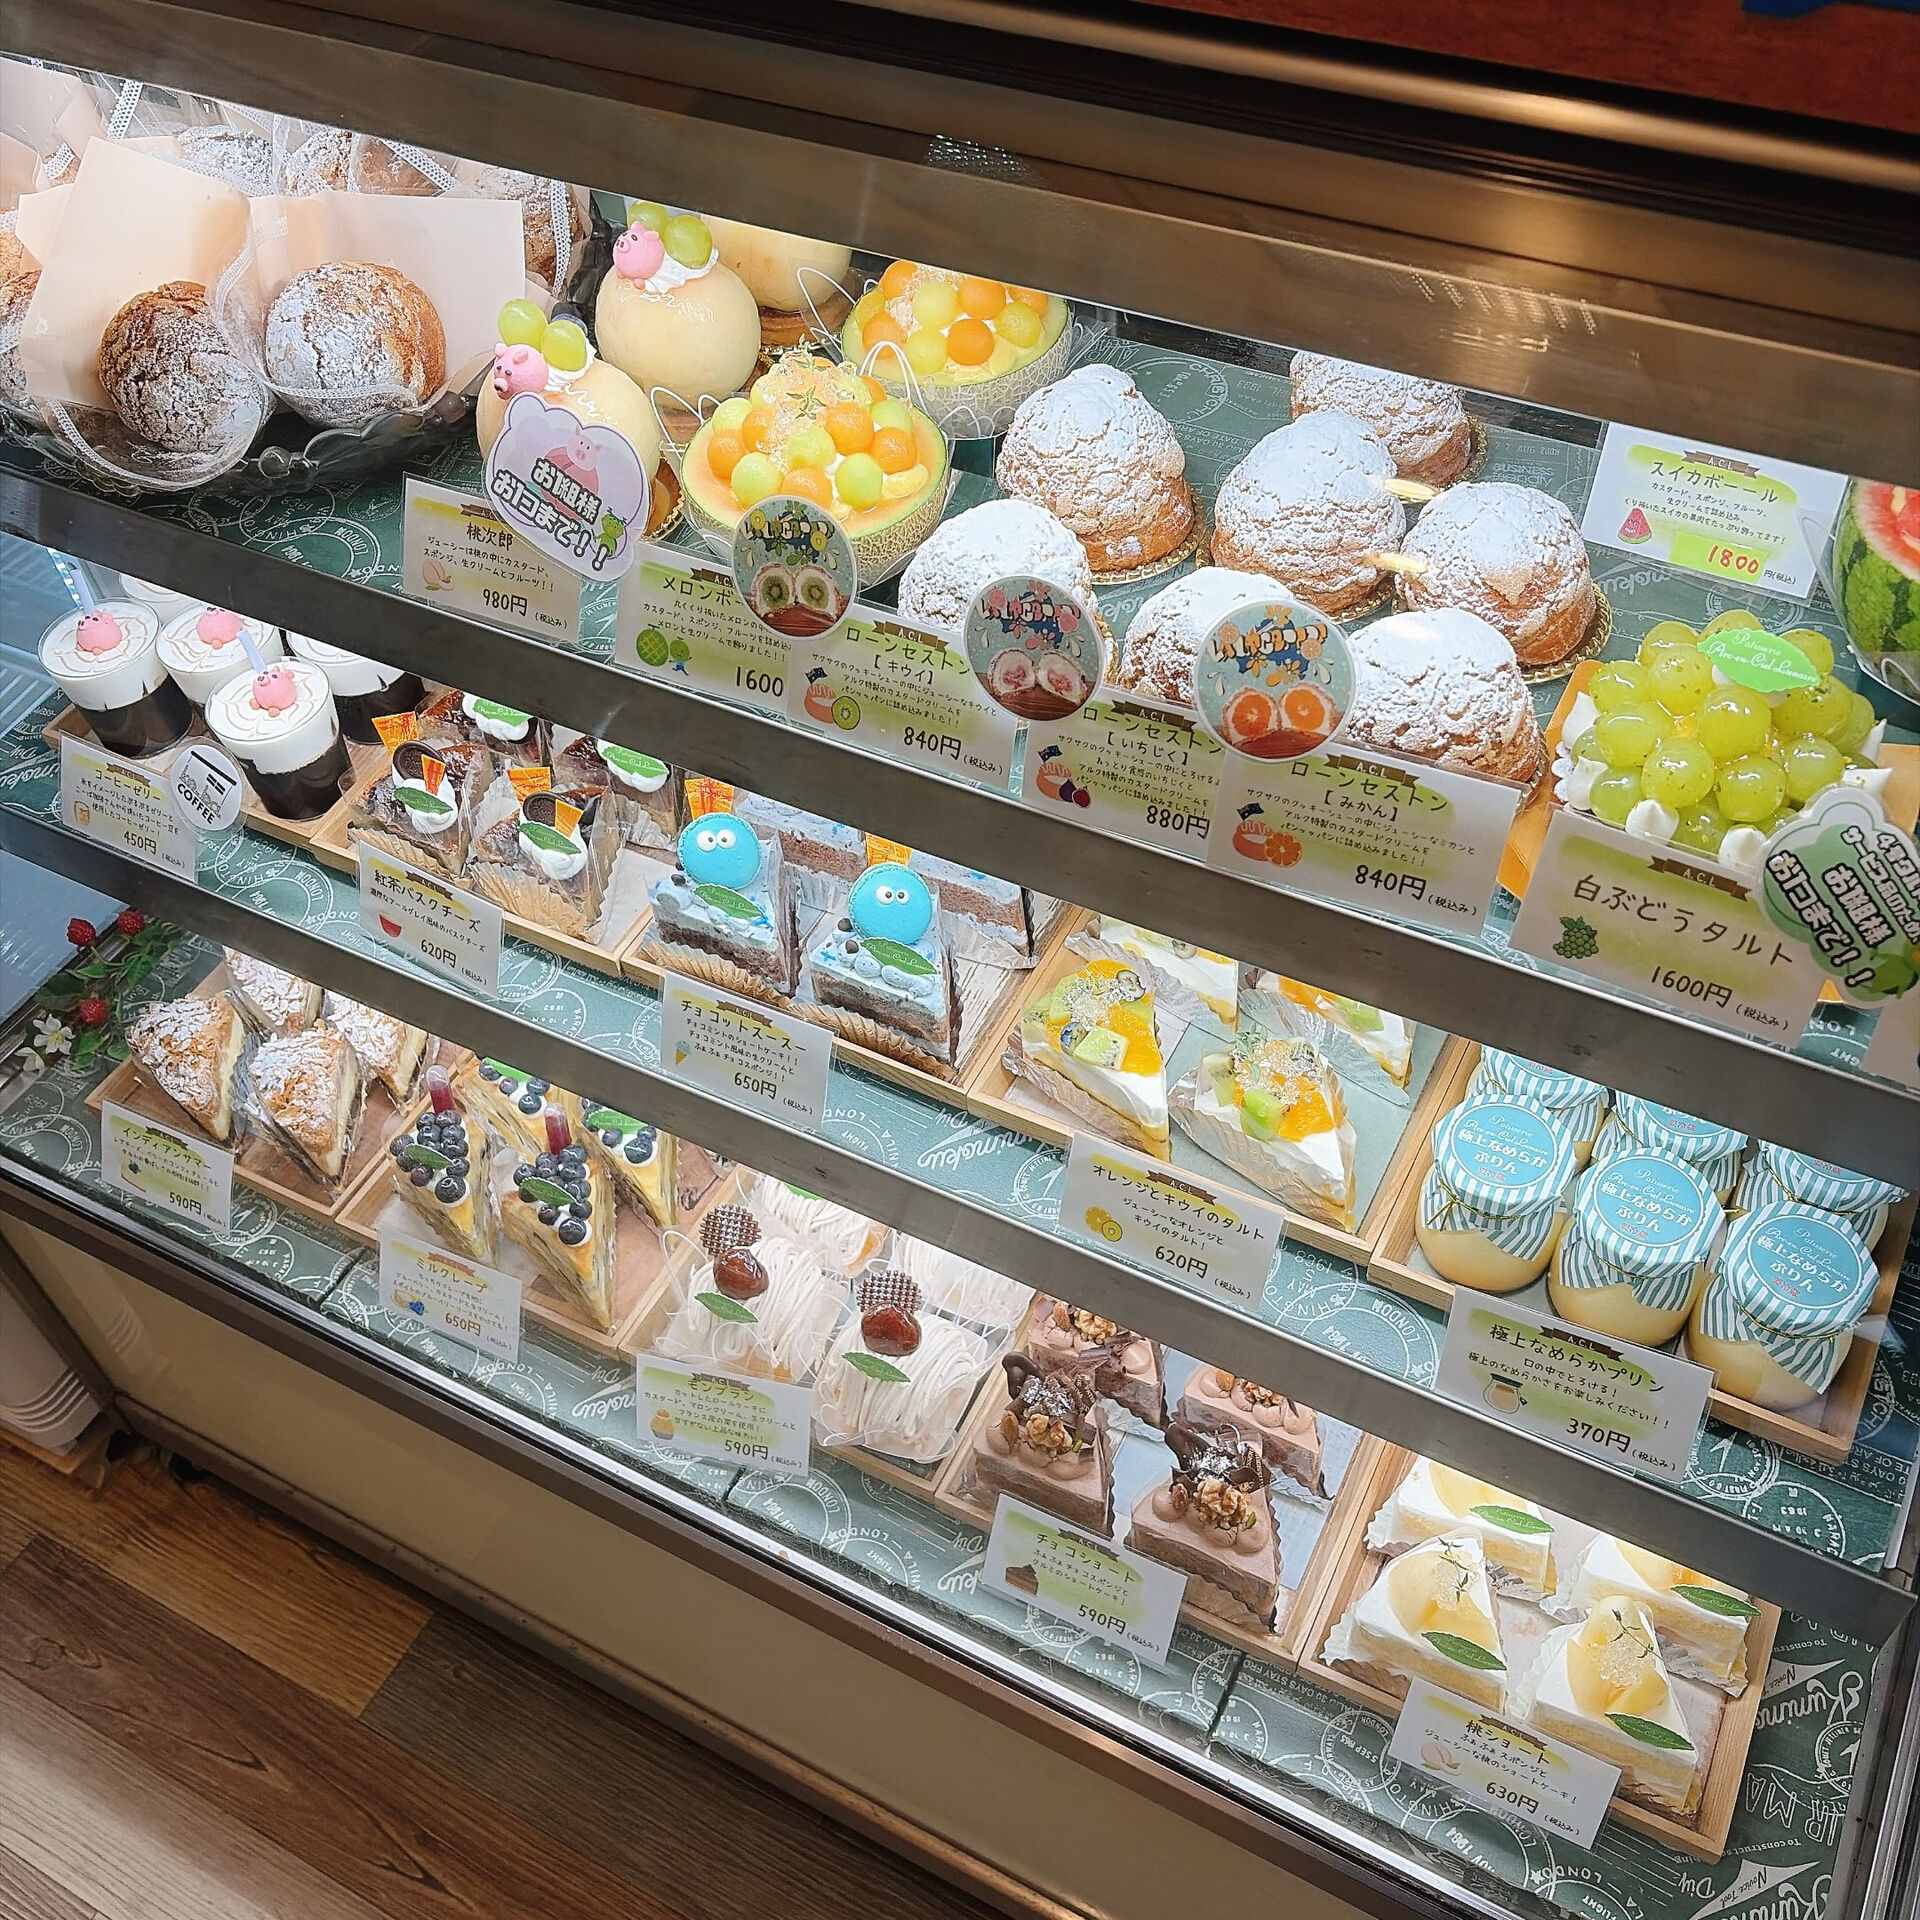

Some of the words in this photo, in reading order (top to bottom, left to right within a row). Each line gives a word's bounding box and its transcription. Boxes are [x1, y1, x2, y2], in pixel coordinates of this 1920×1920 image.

[531, 458, 602, 525] お1組様
[466, 521, 515, 552] 桃次郎
[1708, 544, 1760, 575] 1800
[482, 588, 529, 616] 980円
[534, 610, 569, 629] (税込み)
[846, 626, 971, 675] ローンセストン
[898, 627, 923, 643] A.C.L
[735, 665, 785, 698] 1600
[1083, 706, 1222, 755] ローンセストン
[1139, 710, 1167, 723] A.C.L
[904, 726, 962, 761] 840円
[963, 754, 1003, 775] (税込み)
[1107, 731, 1189, 766] 【いちじく】
[95, 769, 161, 801] コーヒーゼリー
[1290, 761, 1449, 812] ローンセストン
[1355, 763, 1388, 778] A.C.L
[177, 783, 215, 825] COFFEE
[1146, 805, 1210, 840] 880円
[1323, 790, 1399, 822] 【みかん】
[123, 829, 157, 856] 450円
[374, 869, 481, 933] 紅茶バスクチーズ
[1354, 863, 1428, 901] 840円
[1428, 893, 1478, 917] (税込み)
[1821, 862, 1896, 948] お1組様
[1572, 873, 1793, 968] 白ぶどうタルト
[420, 939, 457, 969] 620円
[1650, 965, 1733, 1010] 1600円
[1735, 1004, 1789, 1030] (税込み)
[681, 1000, 807, 1052] チョコットスースー
[734, 1072, 777, 1100] 650円
[123, 1127, 212, 1170] インディアンサマー
[1457, 1127, 1547, 1169] 極上なめらか
[169, 1191, 202, 1216] 590円
[1092, 1164, 1265, 1242] オレンジとキウイのタルト
[1122, 1197, 1224, 1246] ジューシーなオレンジと
[1601, 1181, 1693, 1227] 極上なめらか
[1134, 1214, 1206, 1251] キウイのタルト！
[416, 1257, 488, 1293] ミルクレープ
[1154, 1244, 1210, 1279] 620円
[1214, 1278, 1252, 1300] (税込み)
[1756, 1234, 1848, 1293] 極上なめらか
[445, 1312, 481, 1337] 650円
[1489, 1324, 1665, 1393] 極上なめらかプリン
[1523, 1357, 1618, 1398] 口の中でとろける！
[687, 1380, 755, 1401] モンブラン
[724, 1439, 769, 1461] 590円
[1566, 1417, 1631, 1454] 370円
[1632, 1449, 1676, 1472] (税込み)
[1036, 1533, 1135, 1585] チョコショート
[1077, 1603, 1126, 1635] 590円
[1465, 1719, 1551, 1765] 桃ショート
[1486, 1781, 1540, 1814] 630円
[1786, 1837, 1802, 1847] To
